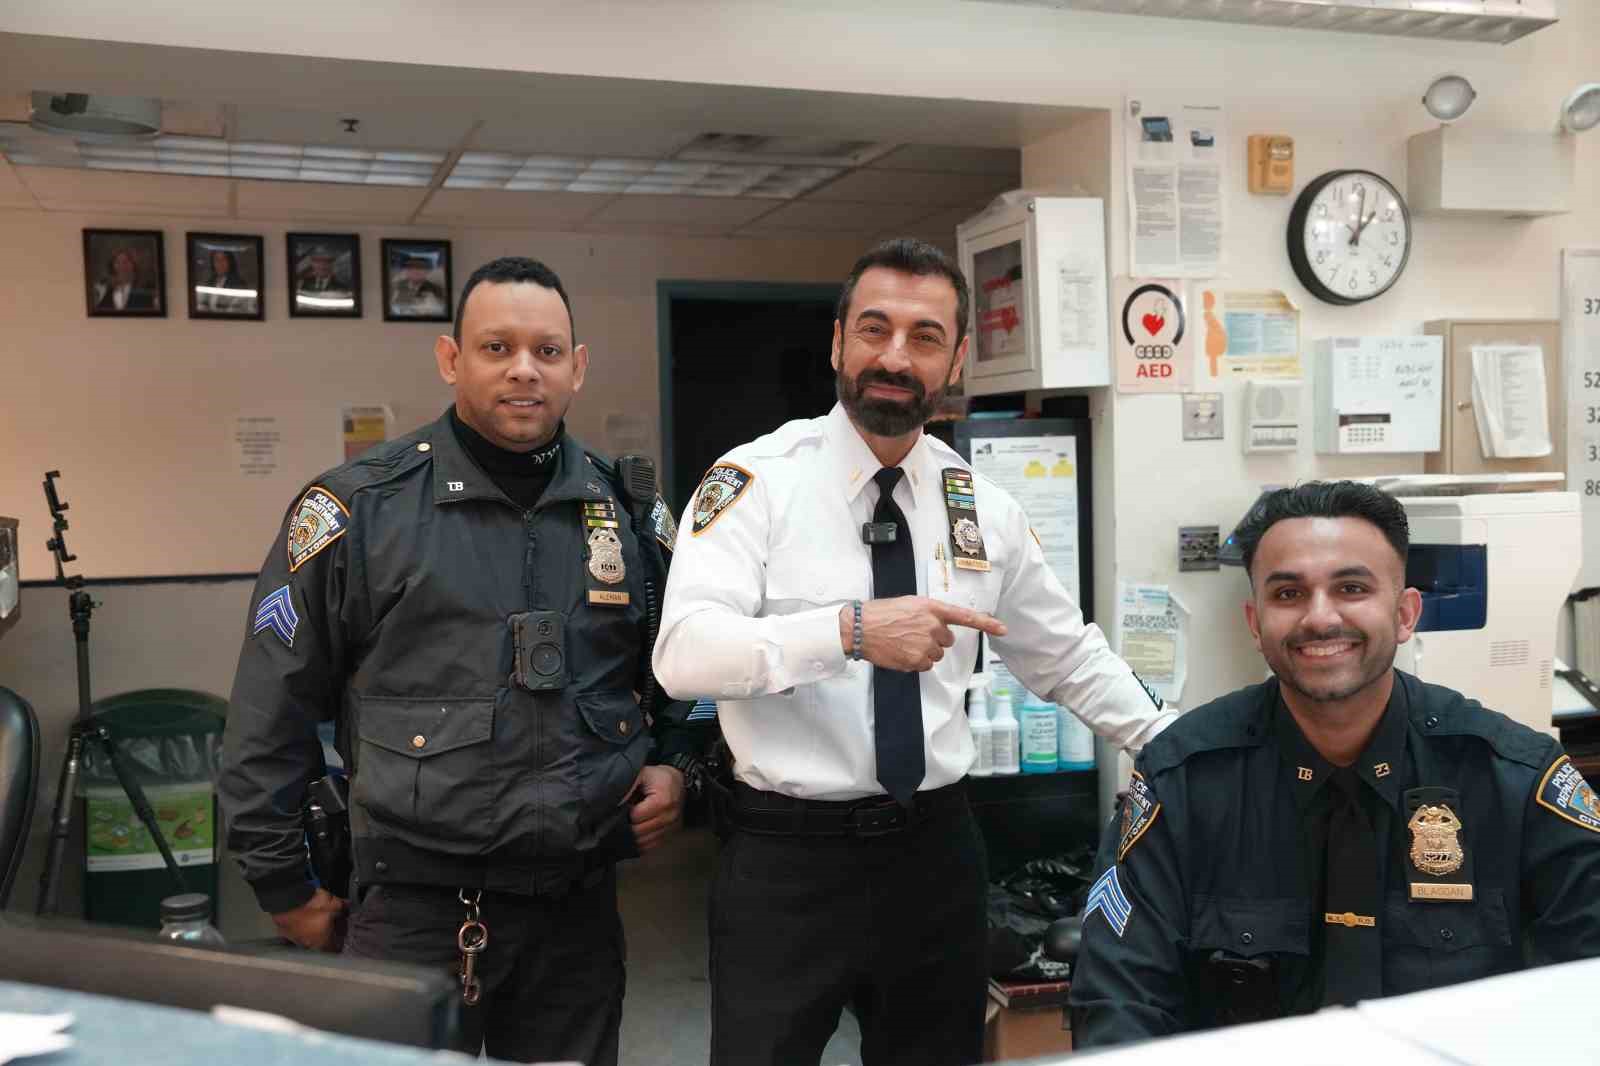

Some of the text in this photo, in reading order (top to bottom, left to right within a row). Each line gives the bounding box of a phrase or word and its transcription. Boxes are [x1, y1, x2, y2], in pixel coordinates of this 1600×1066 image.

[1389, 230, 1399, 246] 3
[1136, 364, 1172, 378] AED
[1588, 445, 1600, 462] 3
[314, 493, 340, 516] POLICE
[309, 533, 331, 553] YORK
[1579, 814, 1600, 827] CIT
